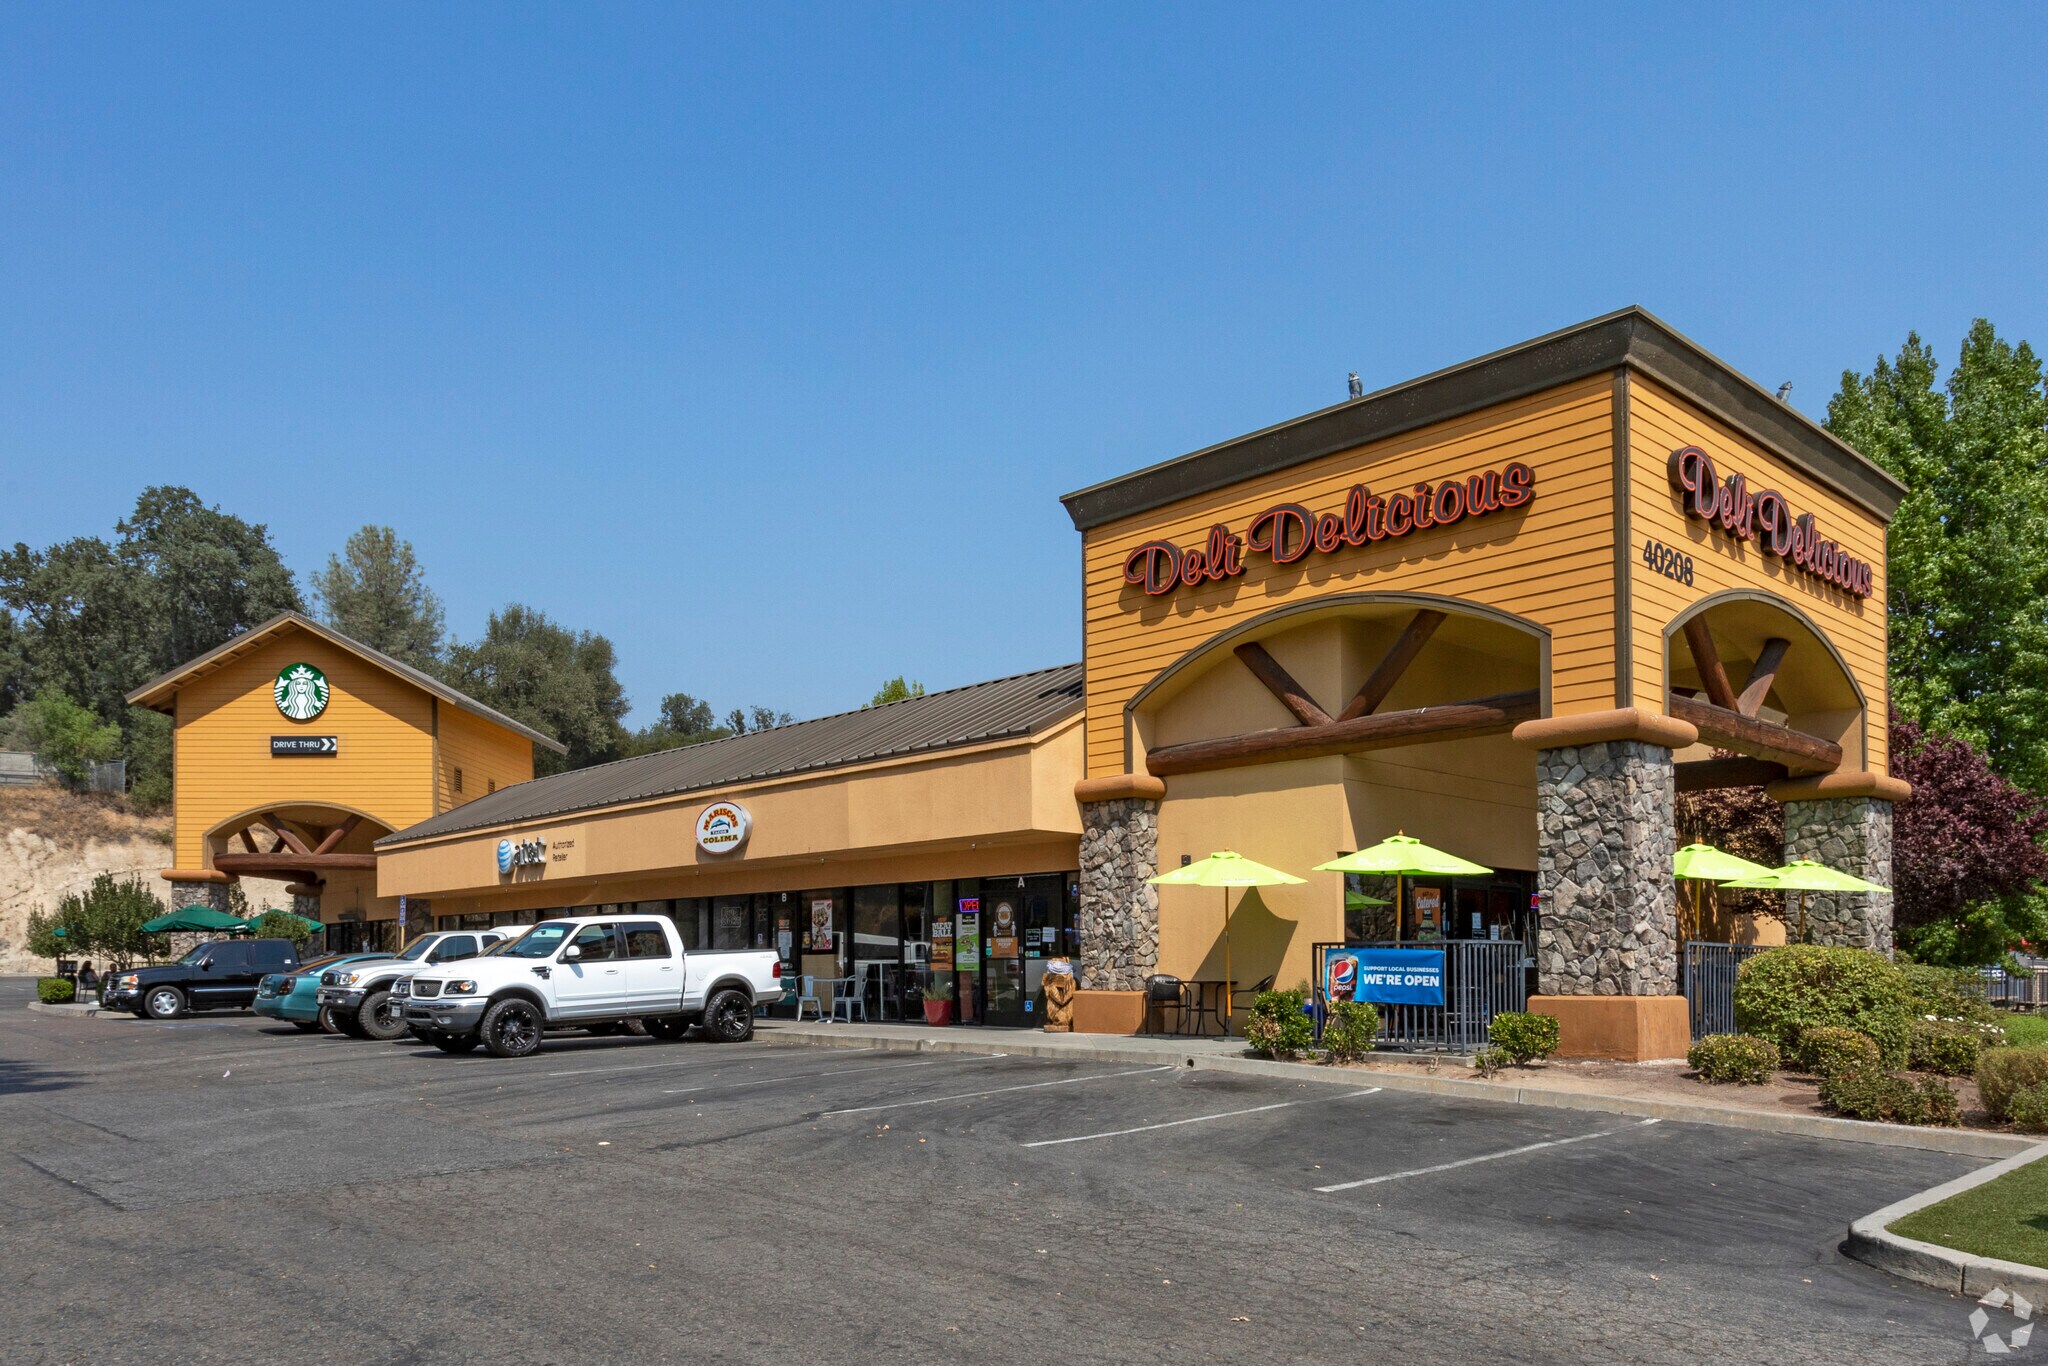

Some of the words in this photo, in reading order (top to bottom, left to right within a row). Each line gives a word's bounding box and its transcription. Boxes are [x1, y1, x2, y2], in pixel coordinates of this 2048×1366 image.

[1123, 523, 1242, 595] Deli
[1246, 462, 1533, 564] Delicious
[1679, 445, 1755, 541] Deli
[1759, 489, 1873, 599] Delicious
[1643, 540, 1694, 587] 40208
[703, 808, 739, 831] MARISCOS
[703, 834, 739, 844] COLIMA
[1017, 876, 1025, 888] A
[781, 892, 787, 902] B
[1363, 973, 1402, 985] WE'RE
[1404, 974, 1440, 987] OPEN
[1333, 984, 1353, 992] pepsi
